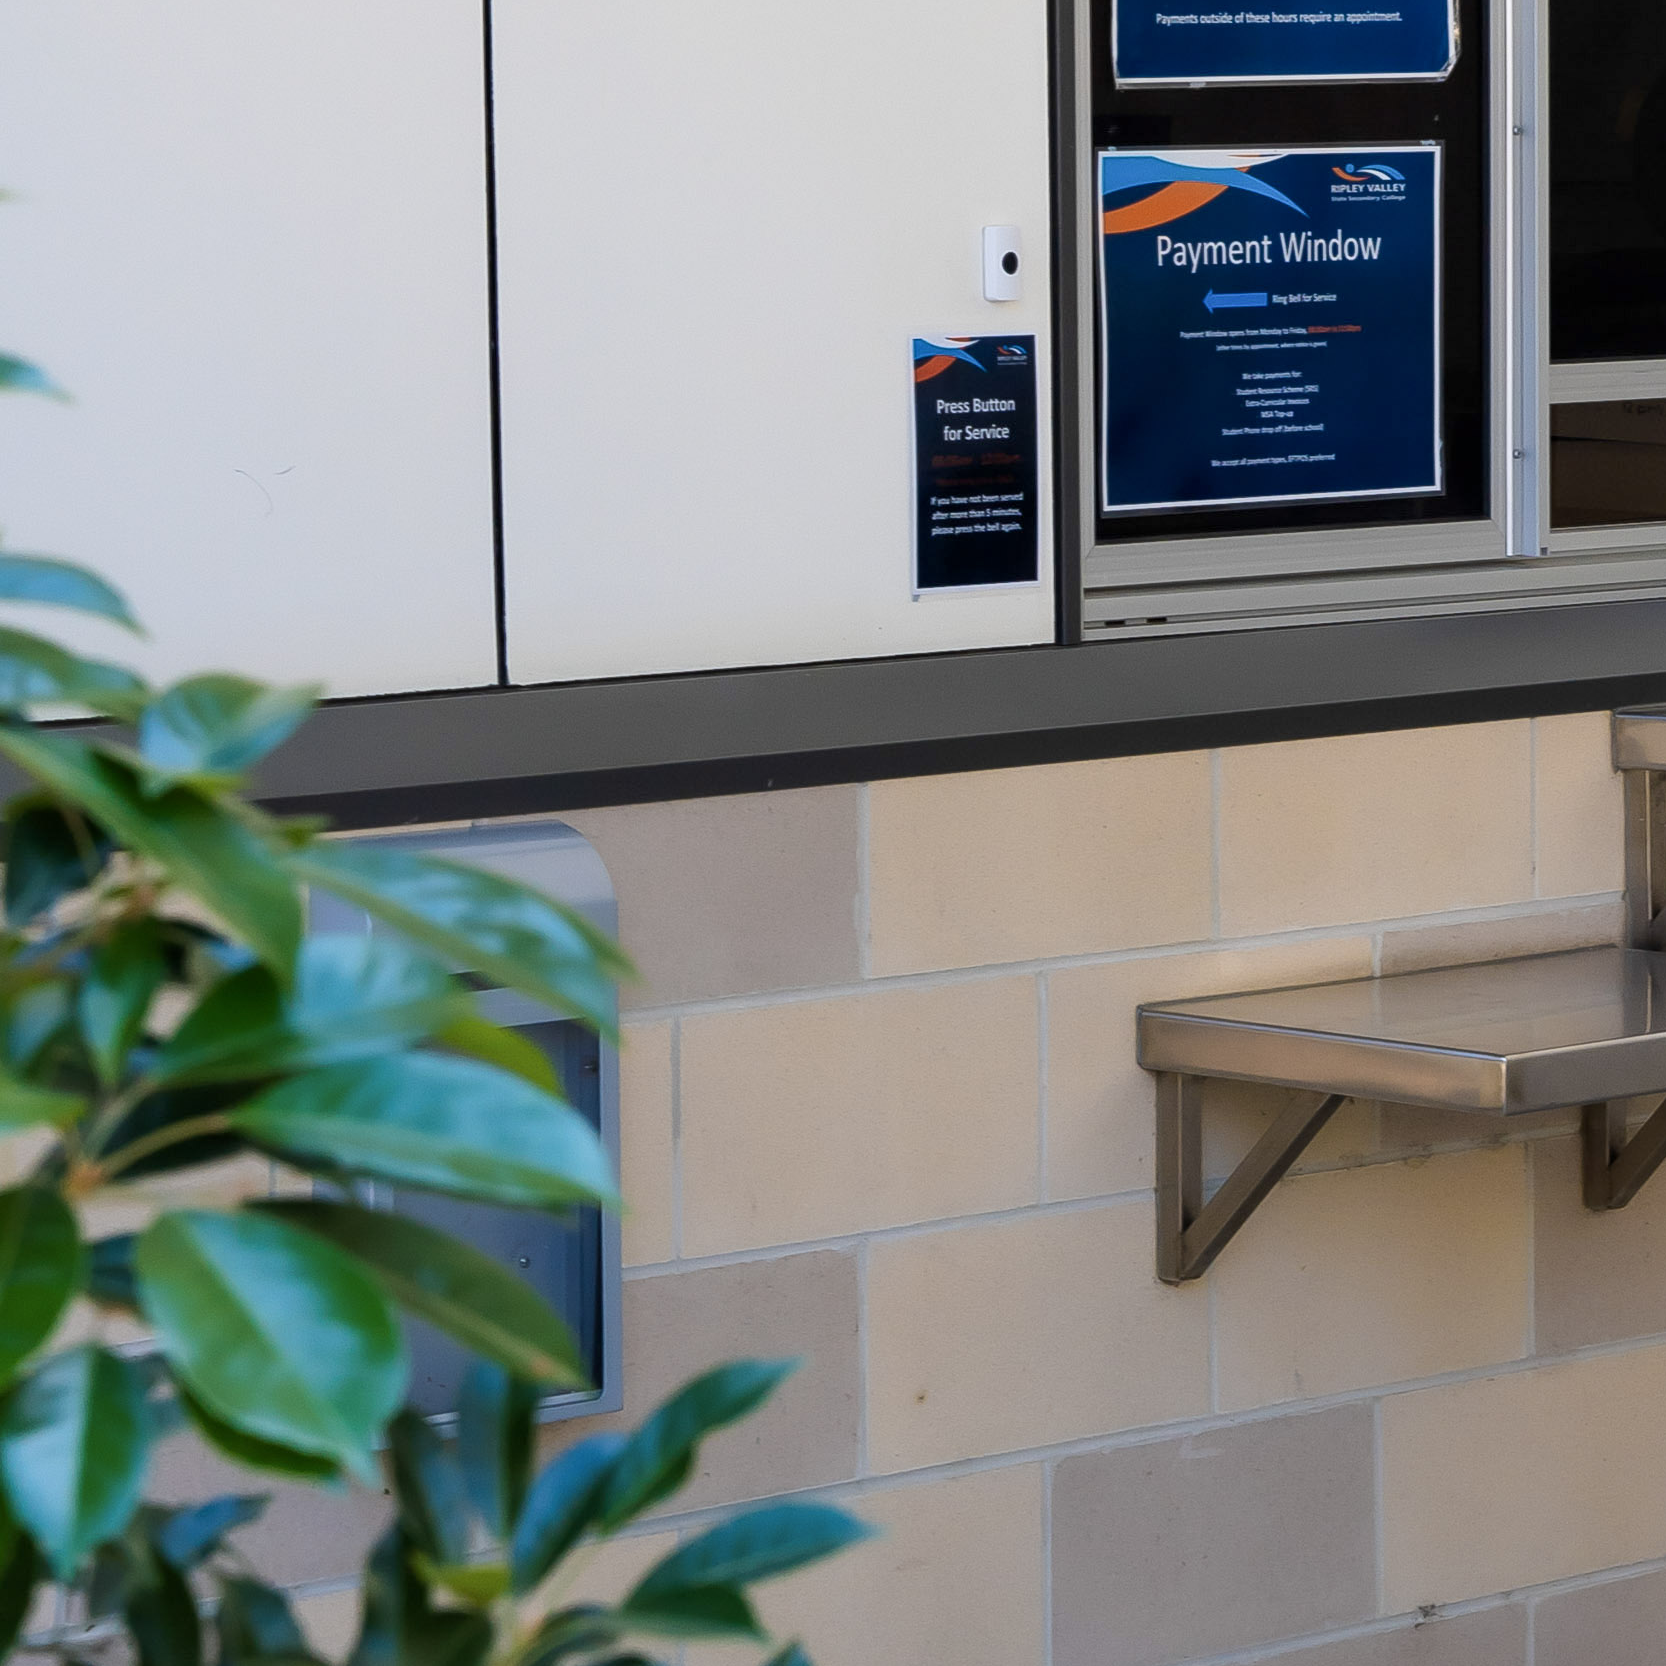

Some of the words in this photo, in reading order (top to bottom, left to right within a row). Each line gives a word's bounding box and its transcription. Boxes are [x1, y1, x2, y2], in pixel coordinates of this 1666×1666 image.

[1156, 14, 1198, 26] Payments
[1200, 12, 1233, 24] outside
[1234, 12, 1245, 23] of
[1246, 12, 1270, 24] these
[1272, 12, 1298, 23] hours
[1300, 11, 1332, 25] require
[1334, 14, 1345, 22] an
[1346, 11, 1403, 25] appointment.
[1330, 184, 1365, 193] RIPLEY
[1367, 183, 1406, 192] VALLEY
[1157, 235, 1273, 273] Payment
[1280, 229, 1382, 263] Window
[1272, 294, 1288, 305] Ring
[1288, 293, 1301, 303] Bell
[1302, 293, 1313, 302] for
[1313, 293, 1337, 302] Service
[936, 399, 970, 414] Press
[973, 398, 1016, 413] Button
[944, 425, 963, 441] for
[965, 424, 1010, 440] Service
[938, 497, 950, 507] you
[951, 495, 968, 504] have
[969, 495, 981, 503] not
[982, 493, 1000, 503] been
[931, 511, 949, 520] after
[969, 509, 985, 518] than
[931, 526, 954, 536] please
[955, 525, 973, 535] press
[974, 524, 986, 533] the
[987, 523, 1000, 532] bell
